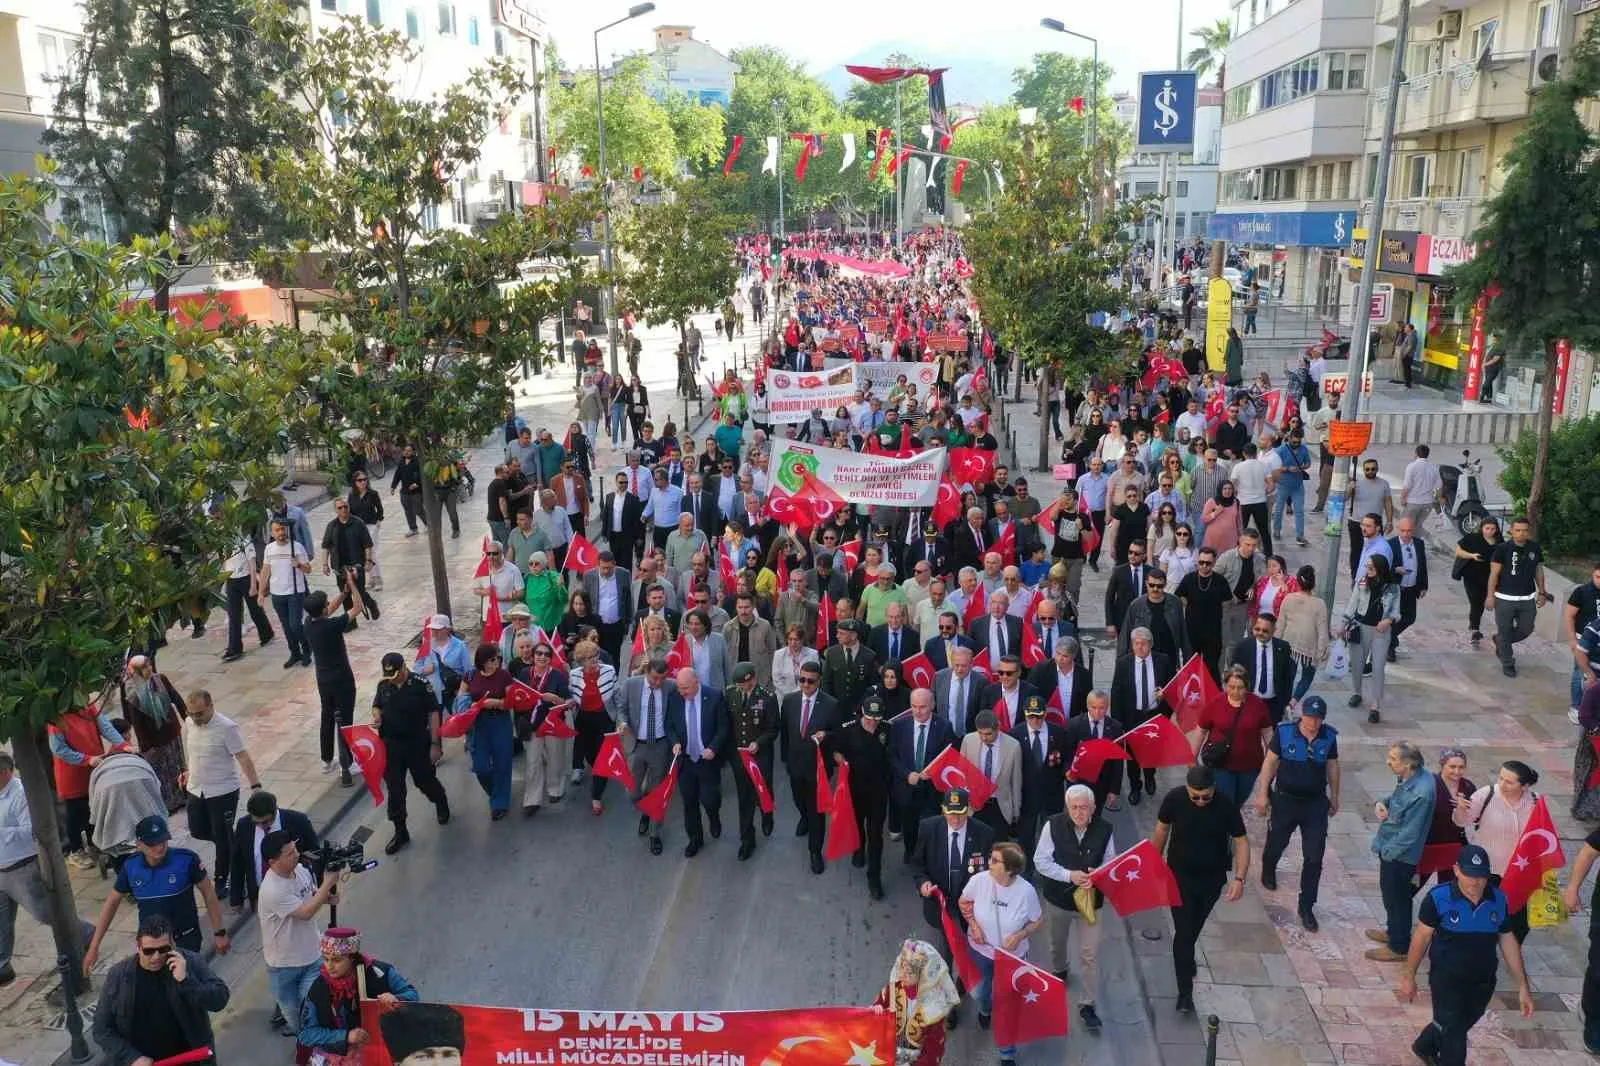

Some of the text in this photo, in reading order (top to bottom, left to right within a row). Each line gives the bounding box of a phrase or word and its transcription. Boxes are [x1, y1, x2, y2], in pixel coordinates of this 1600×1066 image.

[1432, 238, 1474, 260] ECZANE
[1324, 378, 1371, 394] ECZE
[521, 1010, 725, 1033] 15 MAYIS
[559, 1033, 683, 1050] DENİZLİ'DE
[496, 1048, 746, 1066] MİLLİ MÜCADELEMİZİN
